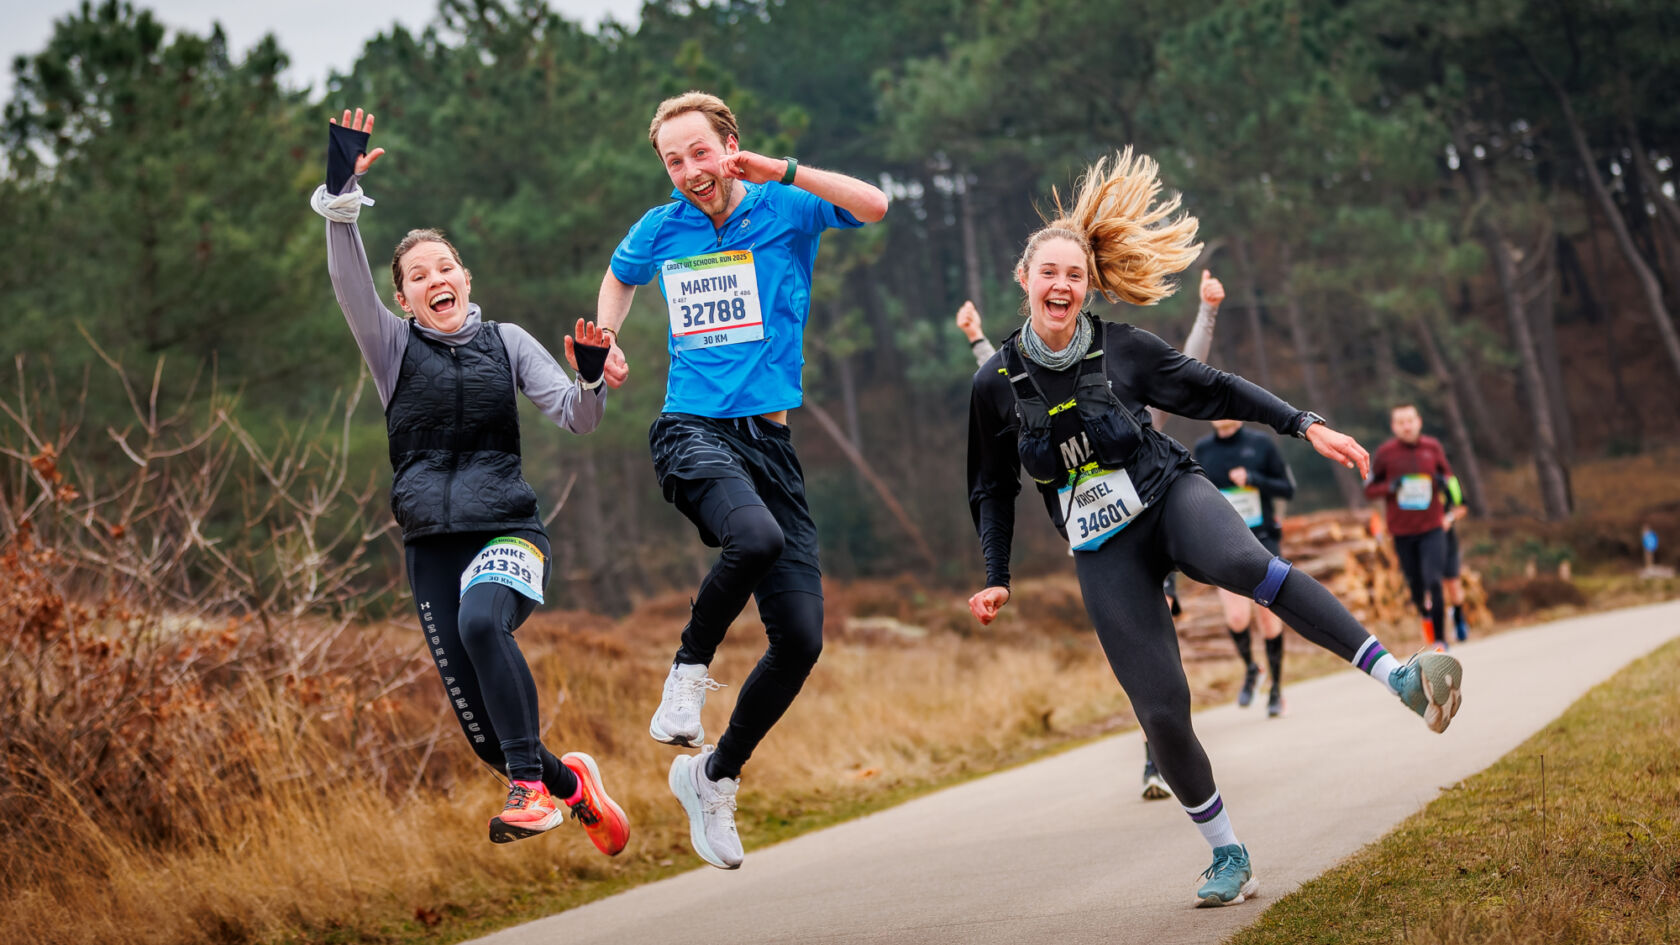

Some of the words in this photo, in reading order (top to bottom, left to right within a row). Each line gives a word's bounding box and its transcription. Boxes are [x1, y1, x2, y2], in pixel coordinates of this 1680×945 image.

[667, 262, 683, 271] GROET
[684, 261, 692, 269] UIT
[693, 257, 719, 267] SCHOORL
[720, 254, 732, 263] RUN
[733, 253, 748, 262] 2025
[680, 274, 738, 296] MARTIJN
[680, 297, 746, 328] 32788
[703, 335, 714, 345] 30
[715, 333, 728, 343] KM
[1075, 481, 1113, 509] KRISTEL
[1077, 498, 1131, 539] 34601
[481, 547, 526, 562] NYNKE
[471, 559, 532, 584] 34339
[501, 577, 514, 586] KM
[423, 611, 448, 668] UNDER
[444, 675, 486, 744] ARMOUR
